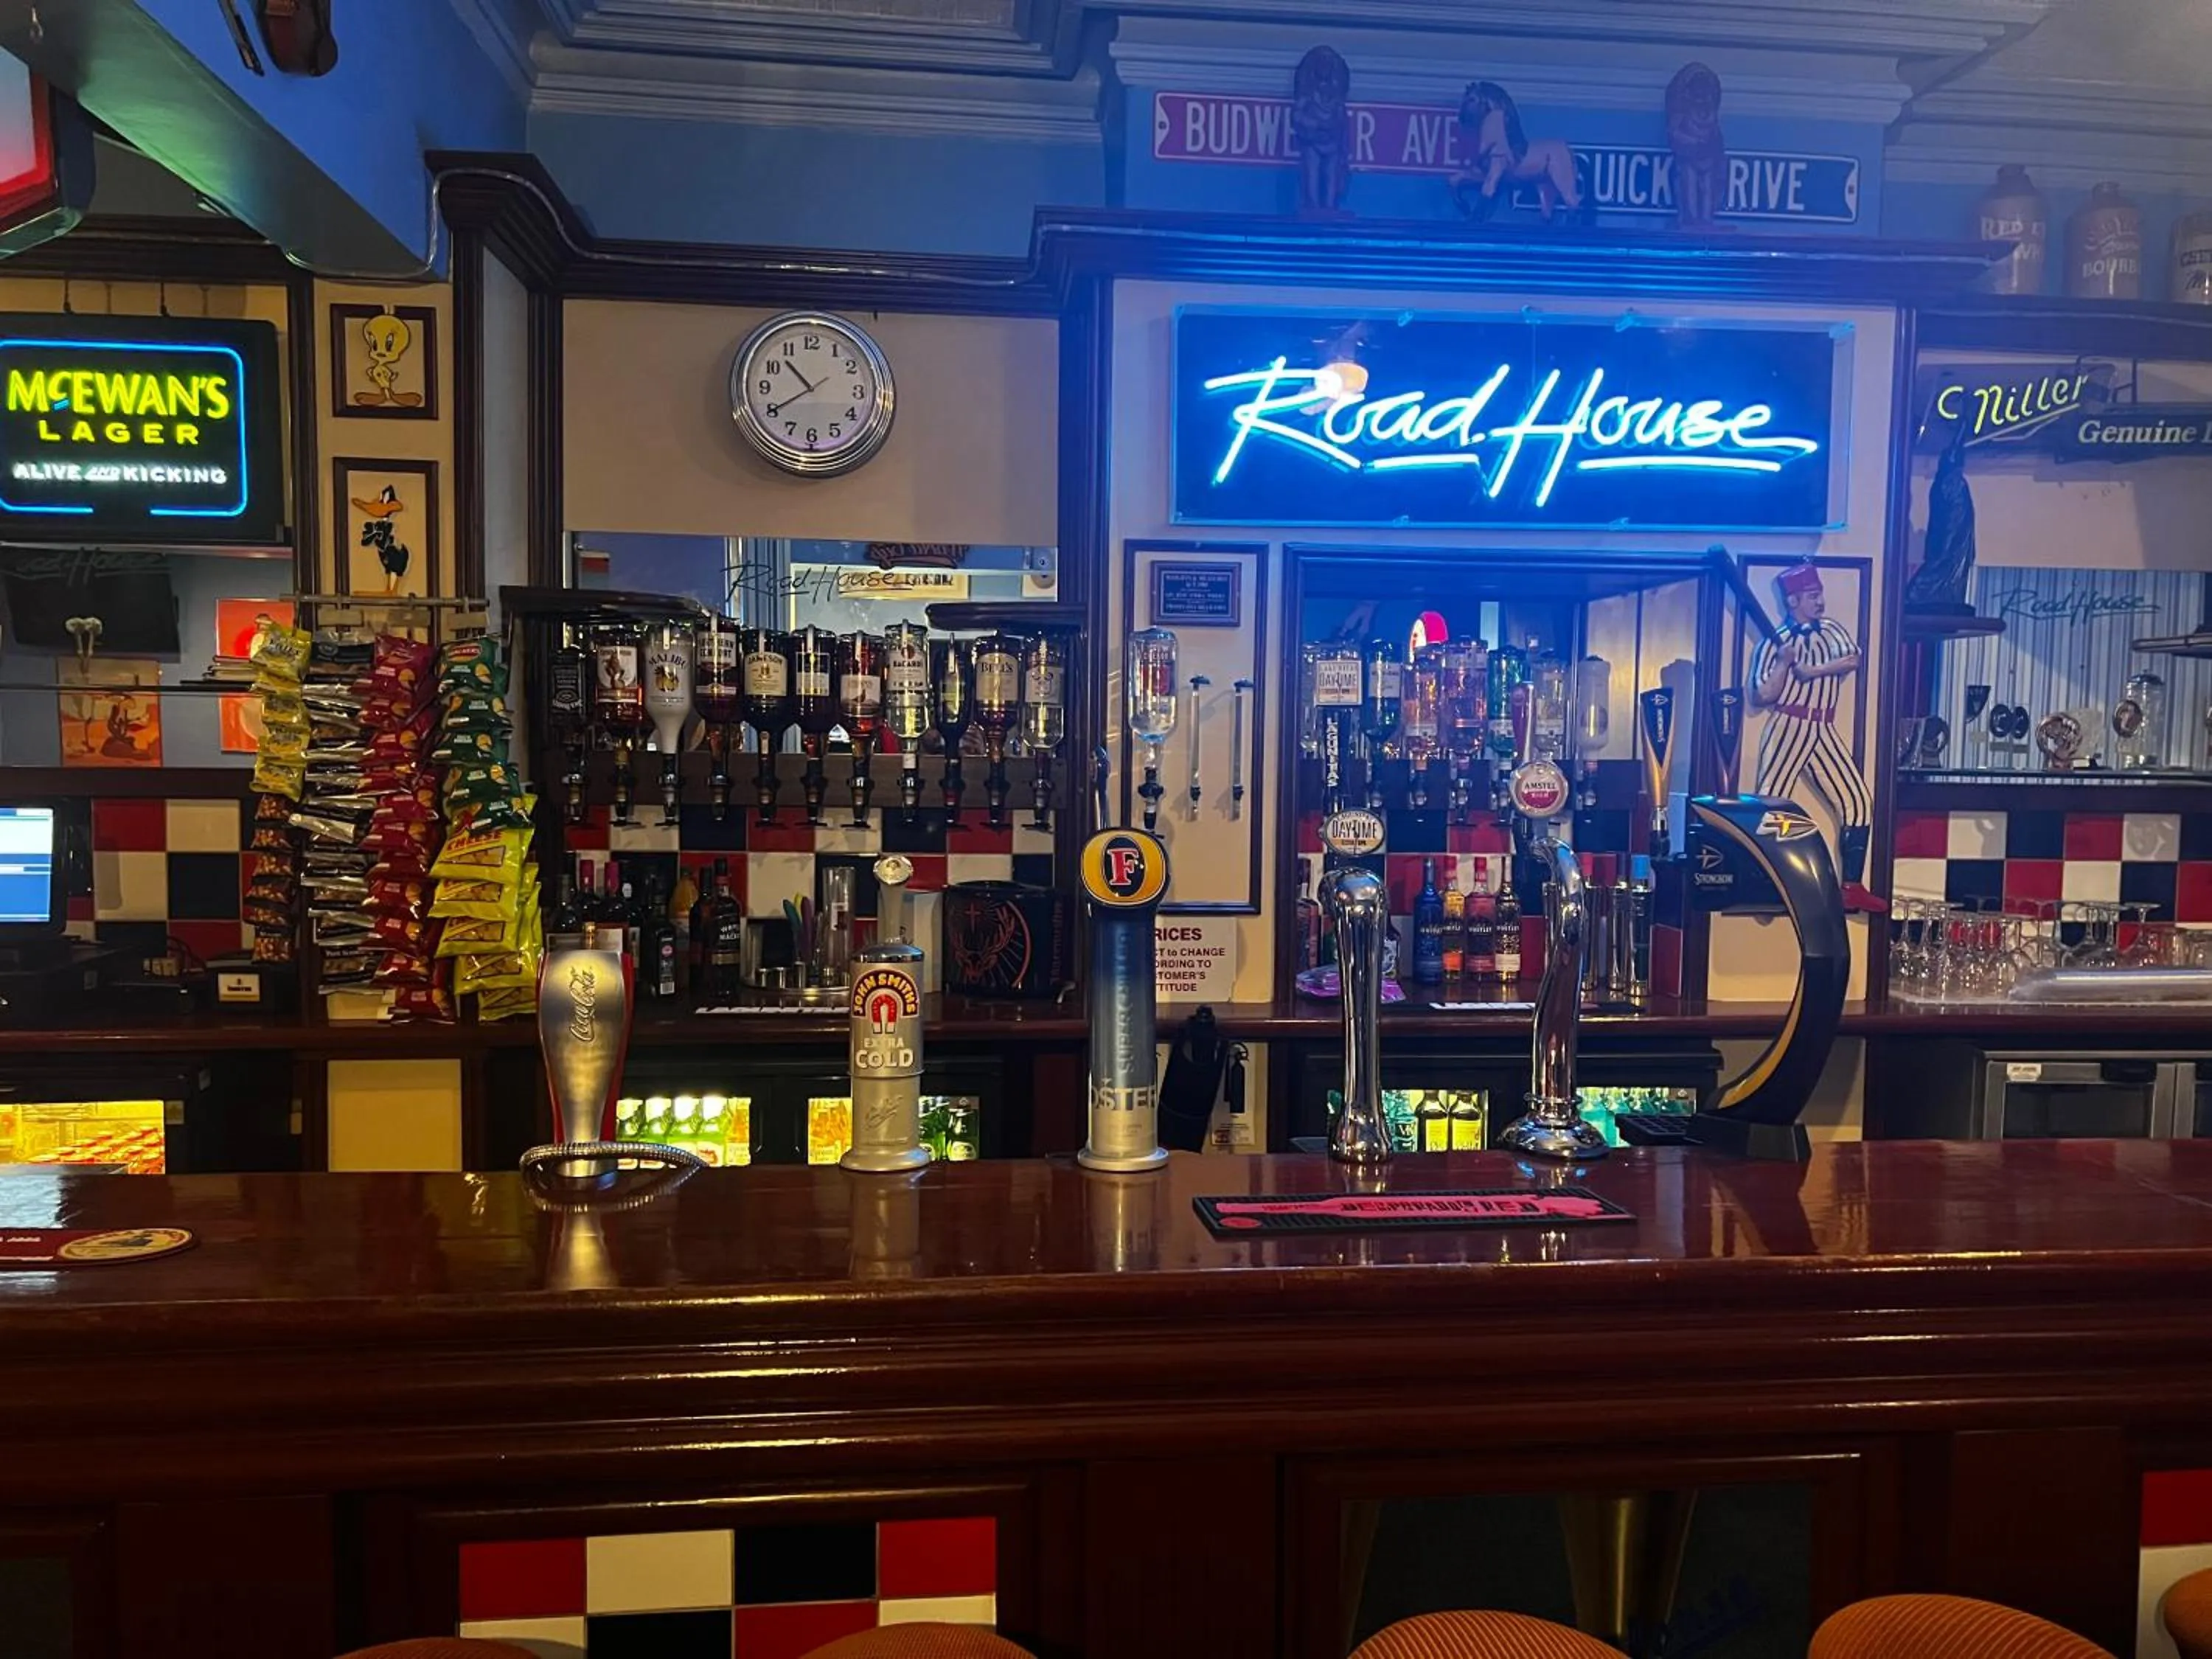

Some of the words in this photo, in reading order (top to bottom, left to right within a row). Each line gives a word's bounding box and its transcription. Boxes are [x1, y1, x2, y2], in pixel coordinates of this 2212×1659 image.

[1185, 101, 1376, 162] BUDWER
[1402, 114, 1472, 166] AVE.
[1728, 159, 1807, 212] RIVE
[783, 342, 794, 356] 11
[804, 335, 820, 350] 12
[832, 344, 838, 358] 1
[766, 360, 780, 375] 10
[846, 360, 857, 374] 2
[759, 380, 771, 394] 9
[852, 385, 864, 400] 3
[766, 403, 779, 418] 8
[845, 407, 857, 421] 4
[38, 420, 199, 445] LAGER
[785, 422, 797, 436] 7
[806, 429, 818, 442] 6
[830, 423, 841, 437] 5
[1205, 356, 1510, 487] Road
[1484, 367, 1818, 507] House
[2078, 420, 2197, 443] Genuine
[13, 462, 83, 481] ALIVE
[122, 465, 228, 484] KICKING
[720, 560, 810, 602] Road
[807, 566, 914, 604] House
[1992, 588, 2072, 622] Road
[2067, 588, 2160, 627] House
[1107, 847, 1139, 886] F
[1155, 927, 1203, 941] RICES
[1180, 947, 1226, 956] CHANGE
[1197, 960, 1211, 968] TO
[1156, 971, 1206, 980] TOMER'S
[853, 974, 877, 1015] JOHN
[877, 973, 919, 1014] SMITH'S
[1156, 983, 1197, 992] TITUDE
[855, 1048, 914, 1068] COLD
